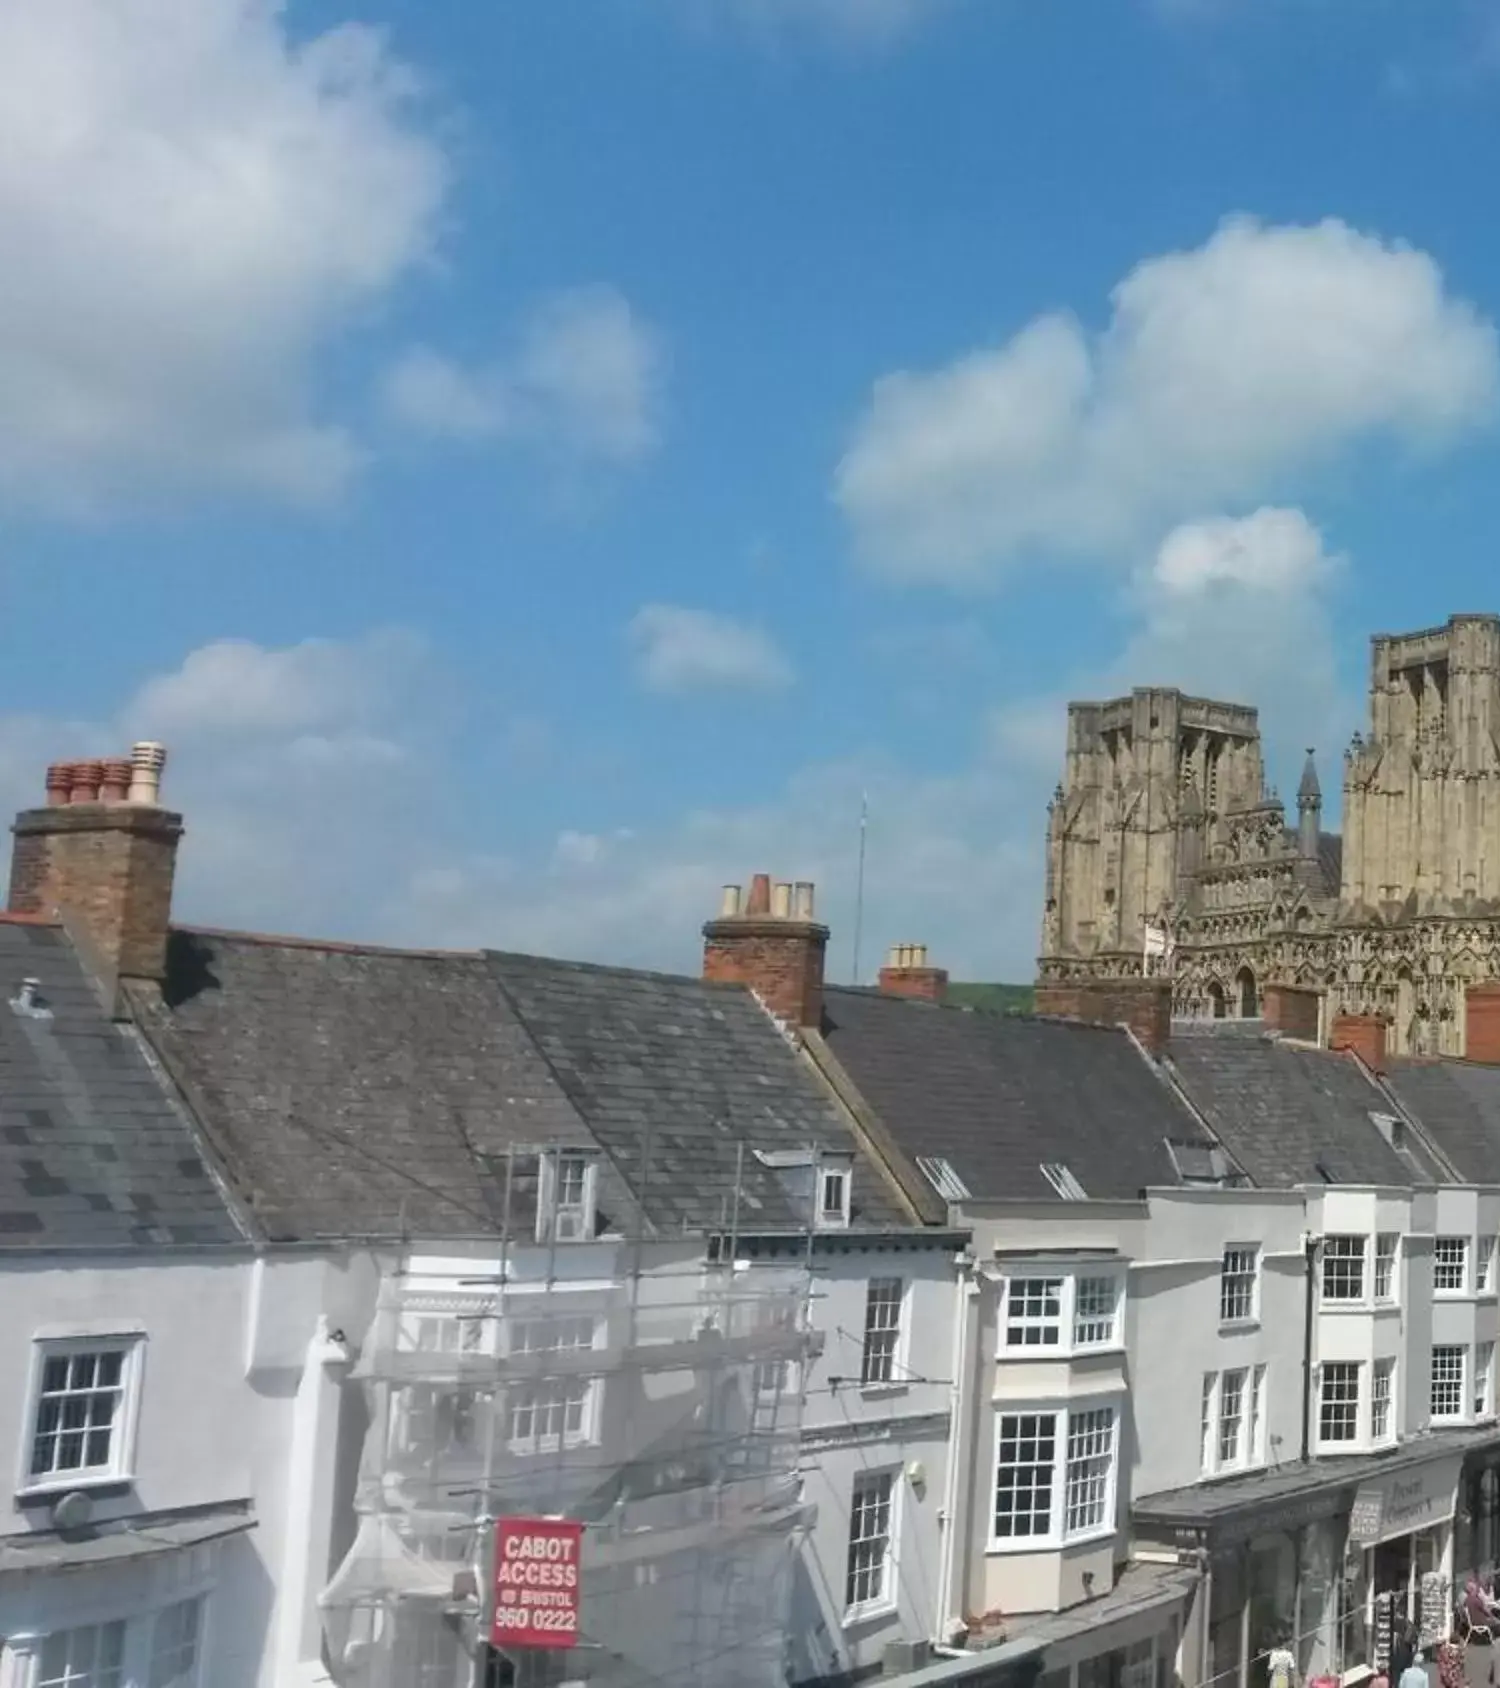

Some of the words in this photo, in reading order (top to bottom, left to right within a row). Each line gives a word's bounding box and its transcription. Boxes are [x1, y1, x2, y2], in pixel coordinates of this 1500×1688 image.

[505, 1536, 574, 1560] CABOT
[498, 1562, 576, 1587] ACCESS
[520, 1590, 573, 1606] BRISTOL
[532, 1609, 576, 1631] 0222
